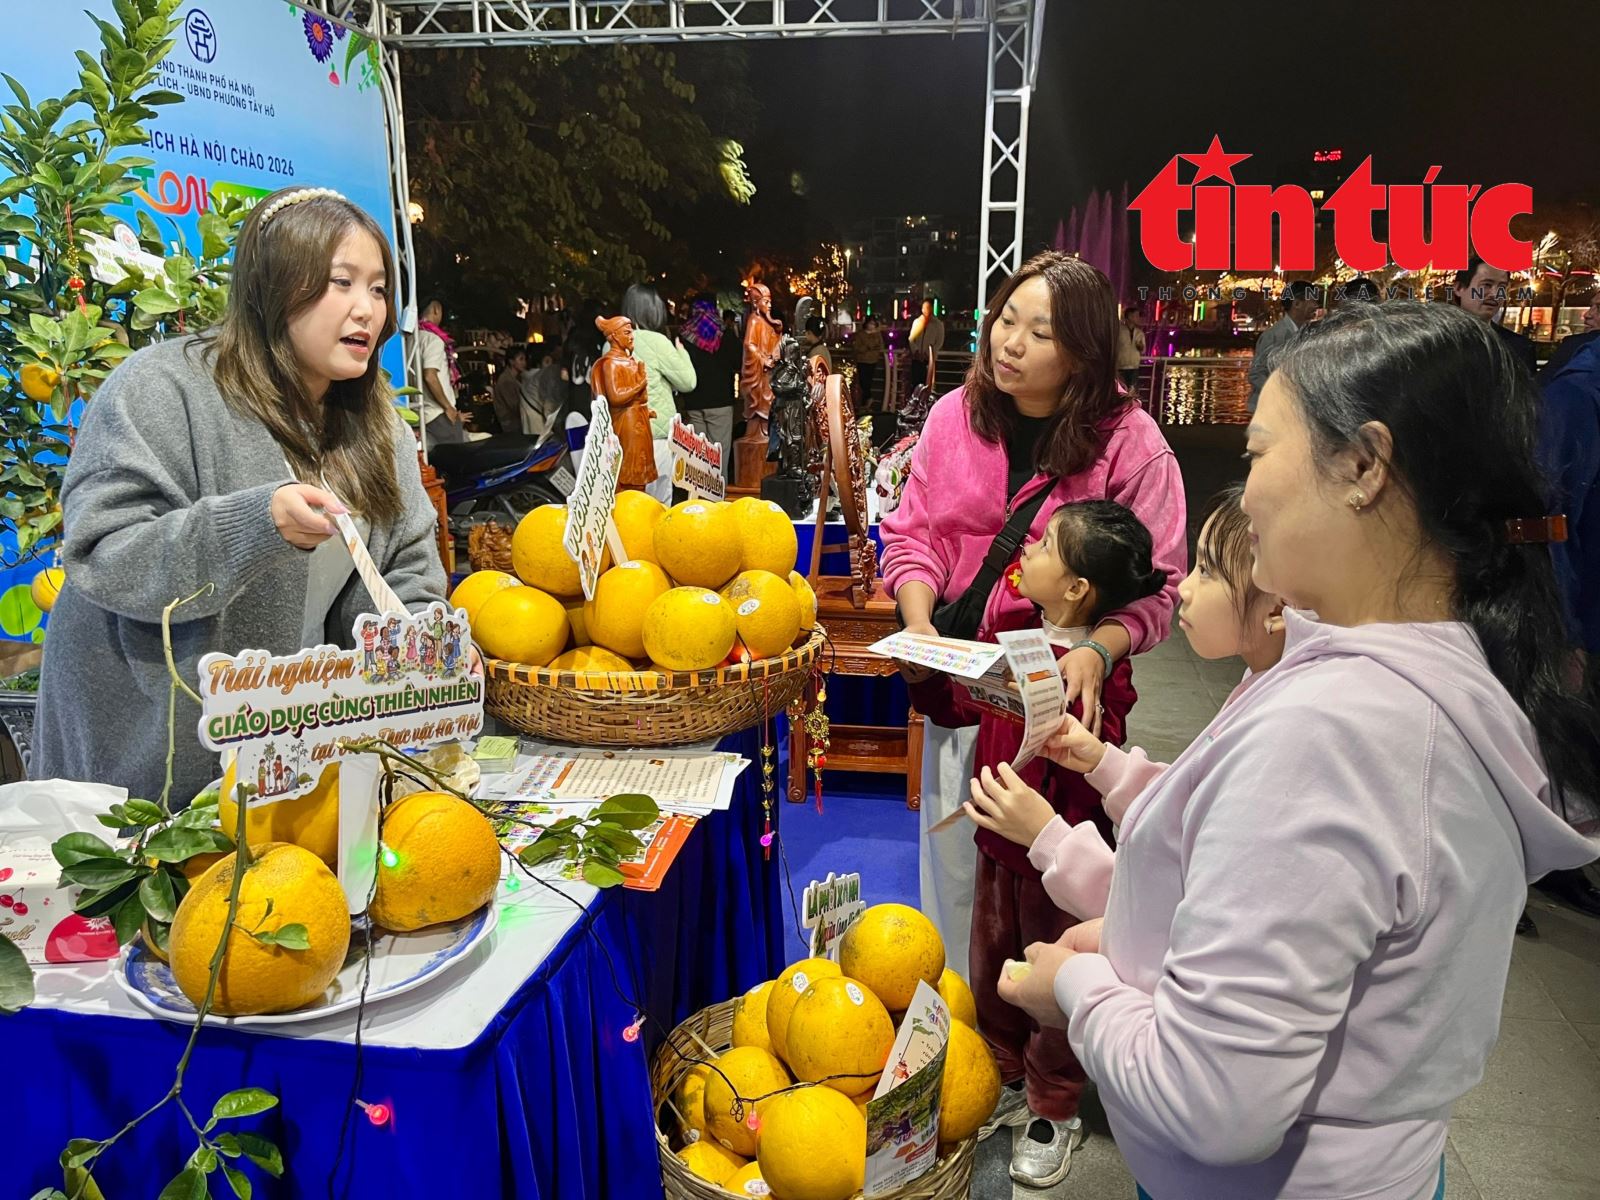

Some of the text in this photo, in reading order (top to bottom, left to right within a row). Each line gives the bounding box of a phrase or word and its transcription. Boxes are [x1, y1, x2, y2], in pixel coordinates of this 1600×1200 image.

[156, 60, 175, 74] BND
[187, 83, 212, 100] UBND
[180, 133, 200, 158] HÀ
[203, 140, 227, 166] NỘI
[231, 146, 264, 170] CHÀO
[267, 156, 295, 177] 2026
[208, 653, 355, 695] Trải nghiệm
[208, 677, 480, 741] GIÁO DỤC CÙNG THIÊN NHIÊN
[311, 738, 336, 765] tại
[411, 722, 435, 745] vật
[435, 717, 455, 738] Hà
[455, 713, 481, 737] Nội
